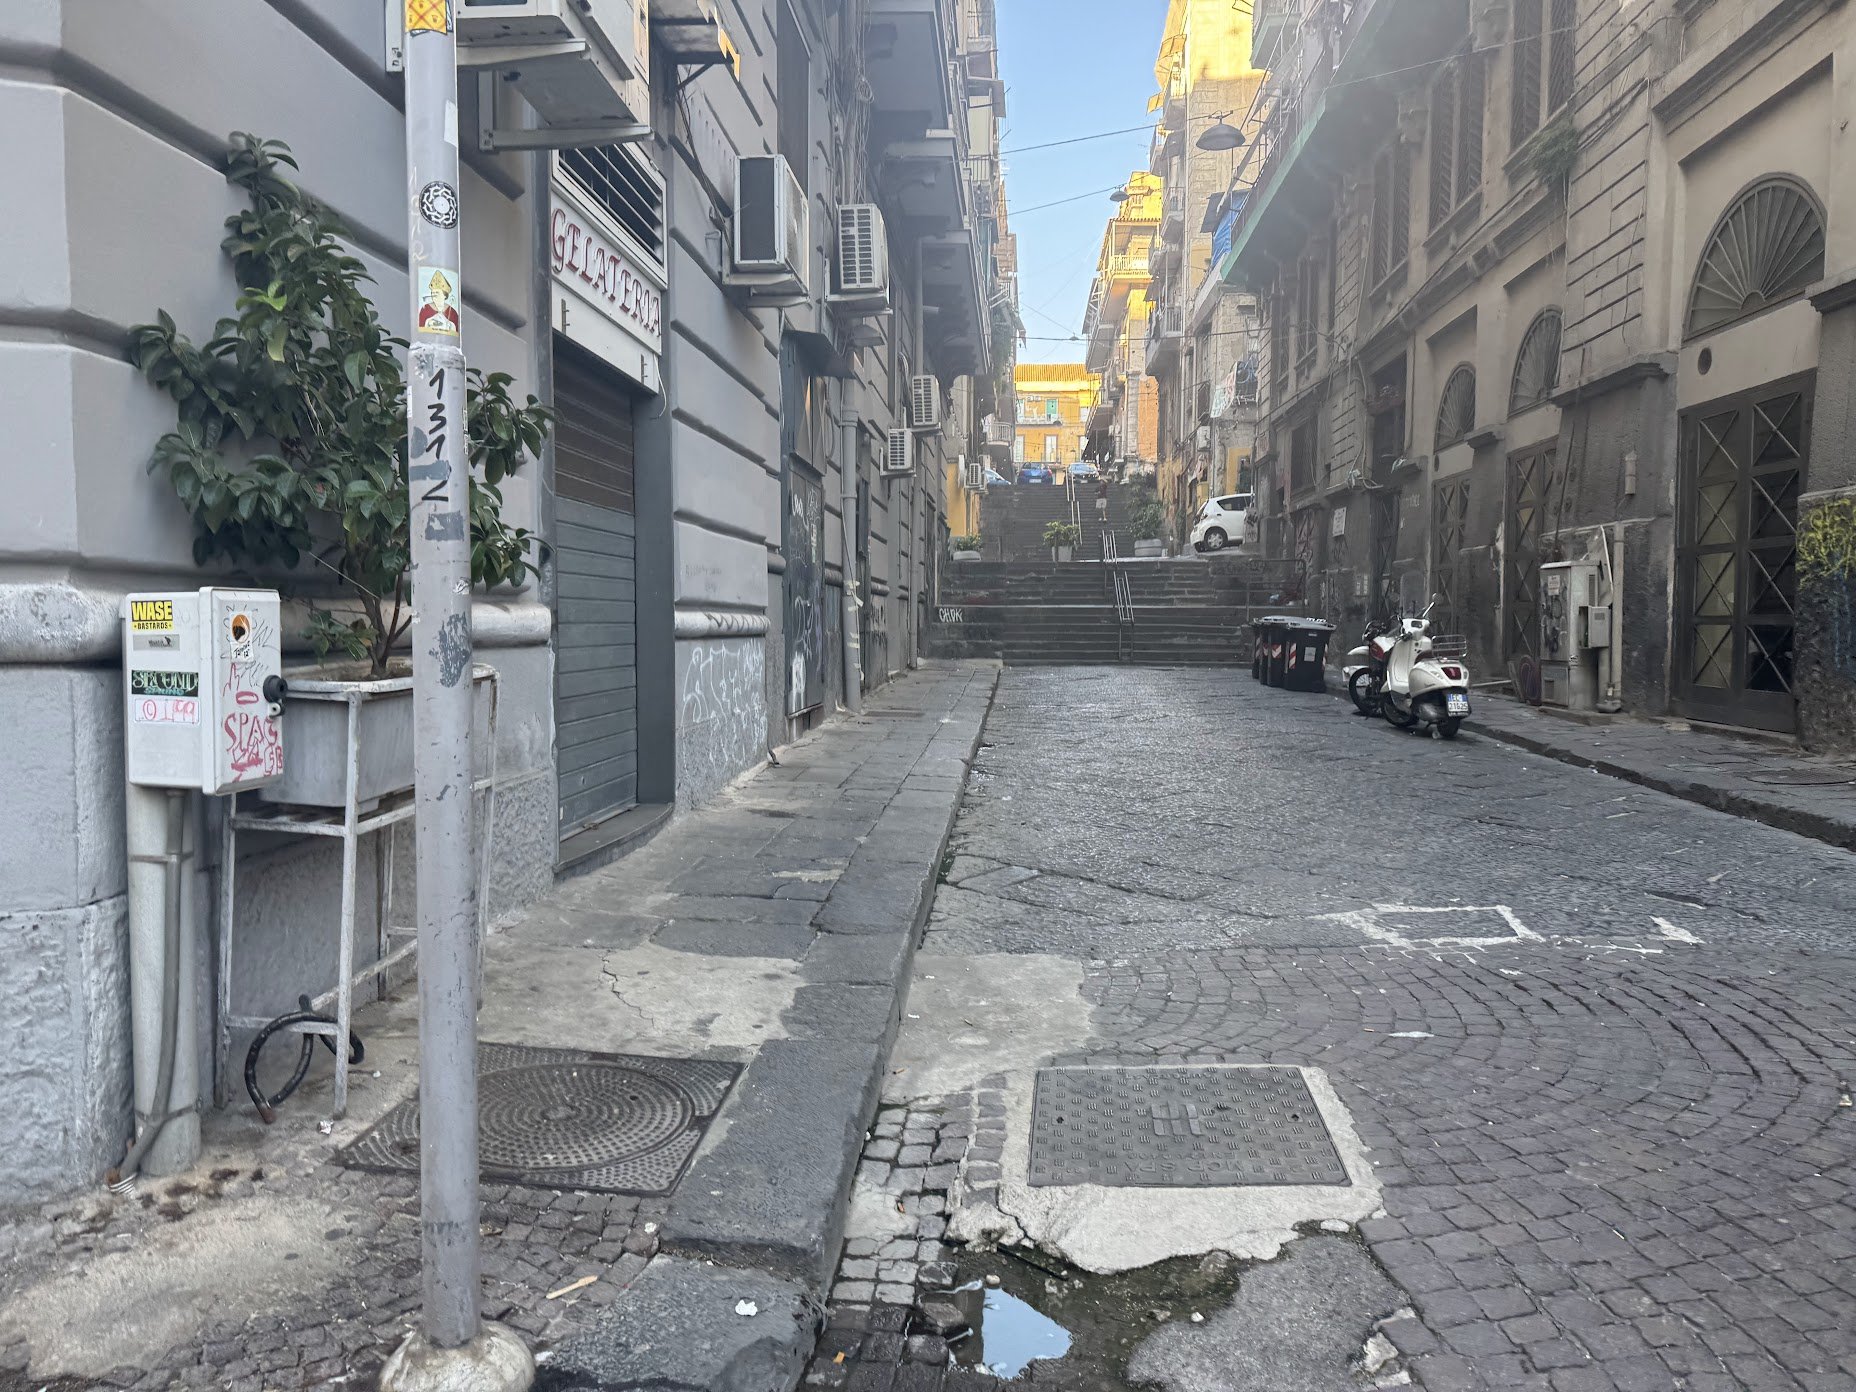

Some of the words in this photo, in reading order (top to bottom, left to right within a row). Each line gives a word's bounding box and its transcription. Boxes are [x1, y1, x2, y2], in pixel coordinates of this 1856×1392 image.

[551, 208, 662, 338] GELATERIA
[131, 601, 173, 621] WASE
[137, 621, 169, 630] BASTARDS
